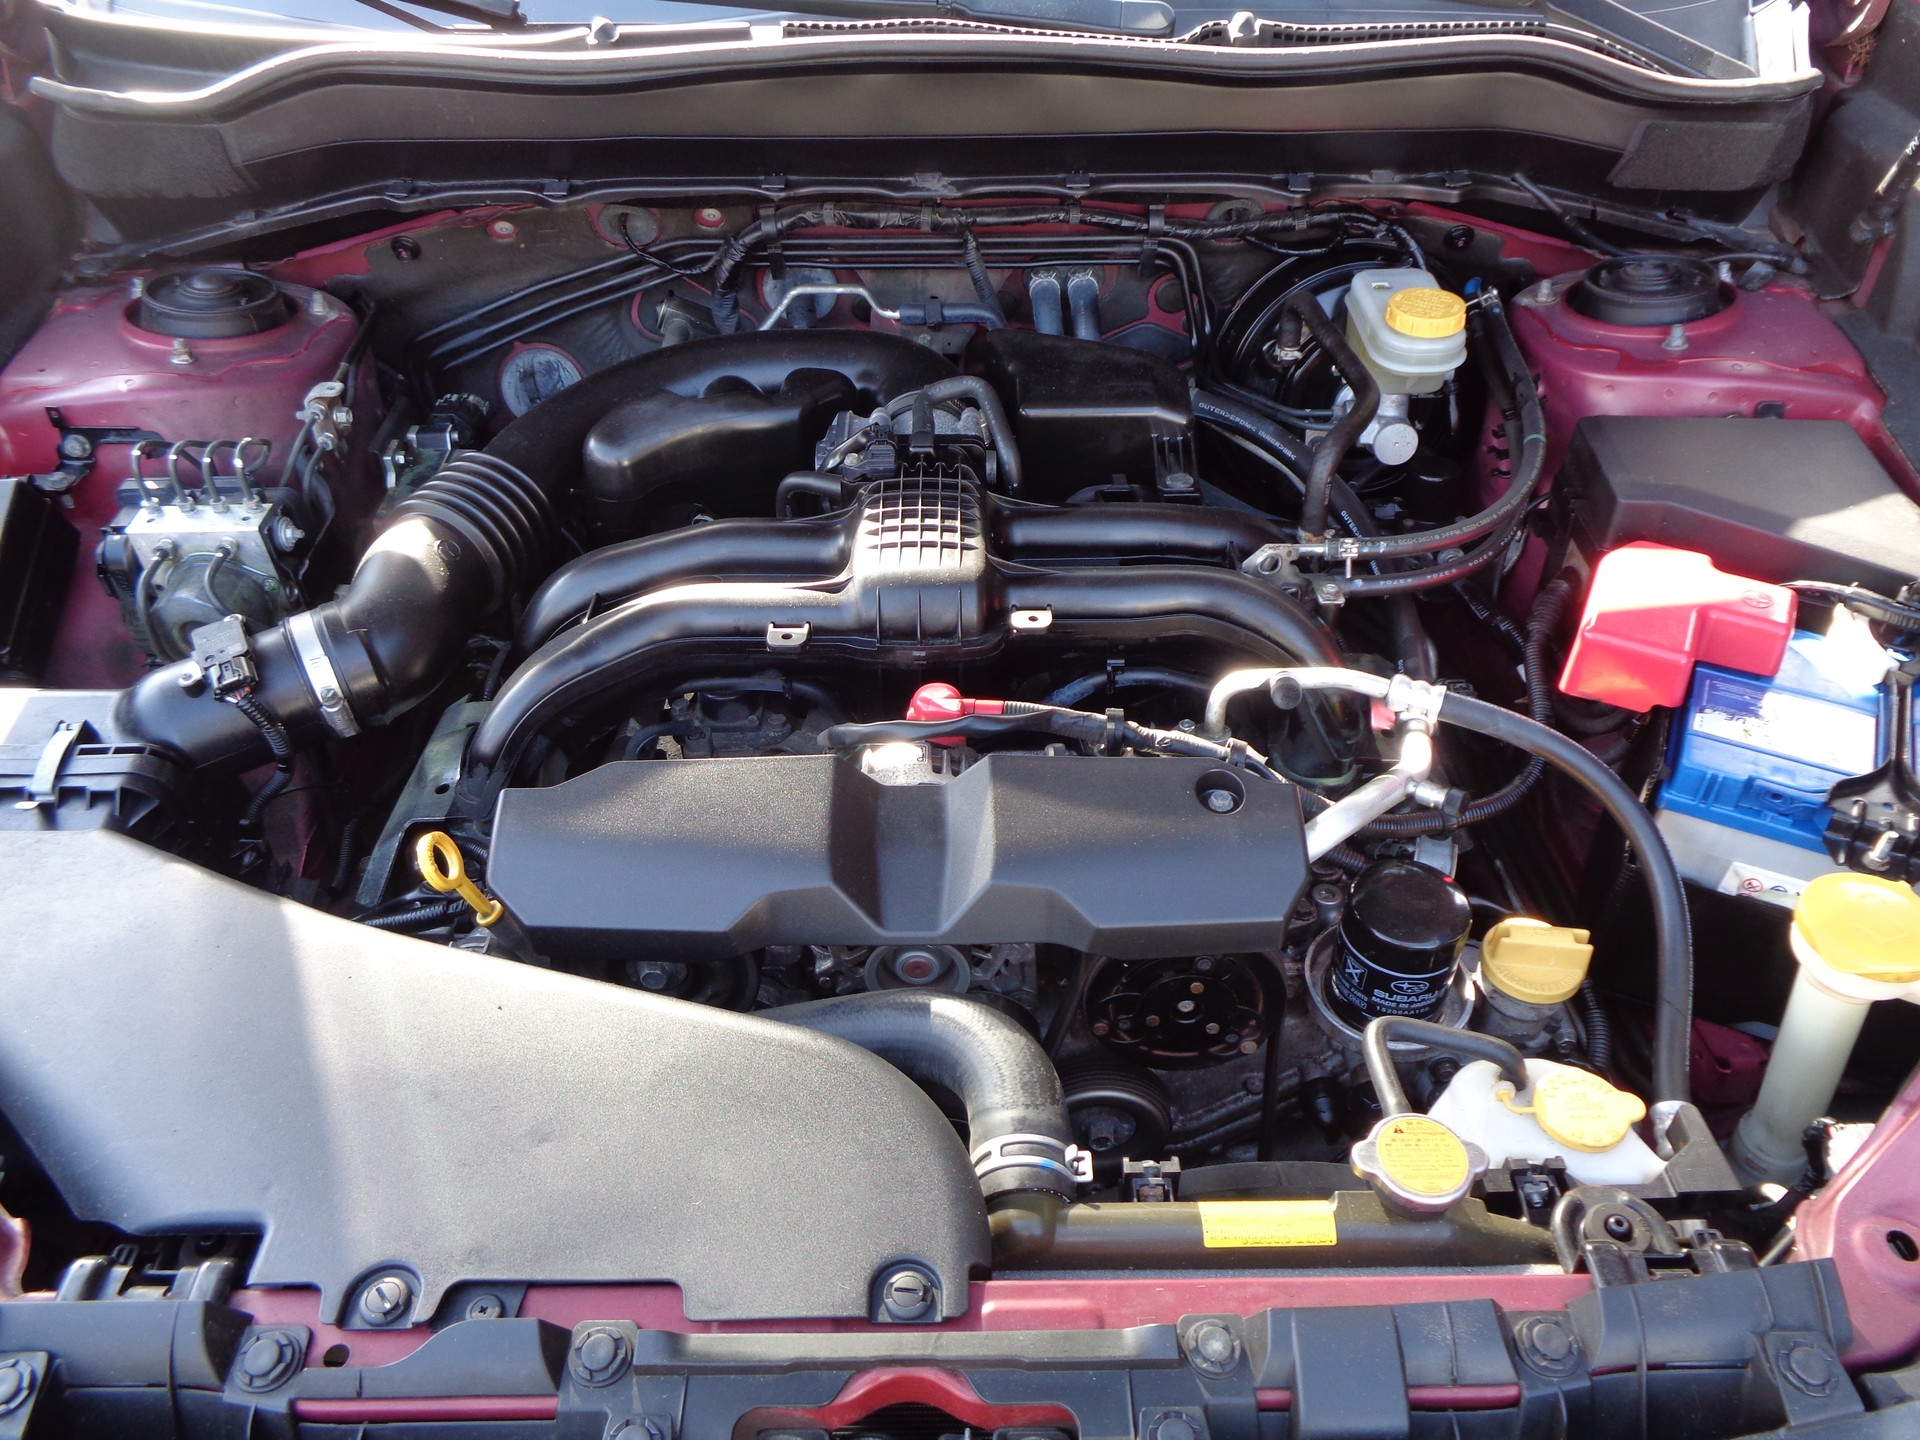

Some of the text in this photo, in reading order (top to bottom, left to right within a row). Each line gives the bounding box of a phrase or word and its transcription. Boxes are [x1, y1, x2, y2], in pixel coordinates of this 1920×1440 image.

[1373, 988, 1439, 1002] SUBARU
[1371, 996, 1397, 1007] MADE
[1410, 997, 1436, 1008] JAPAN
